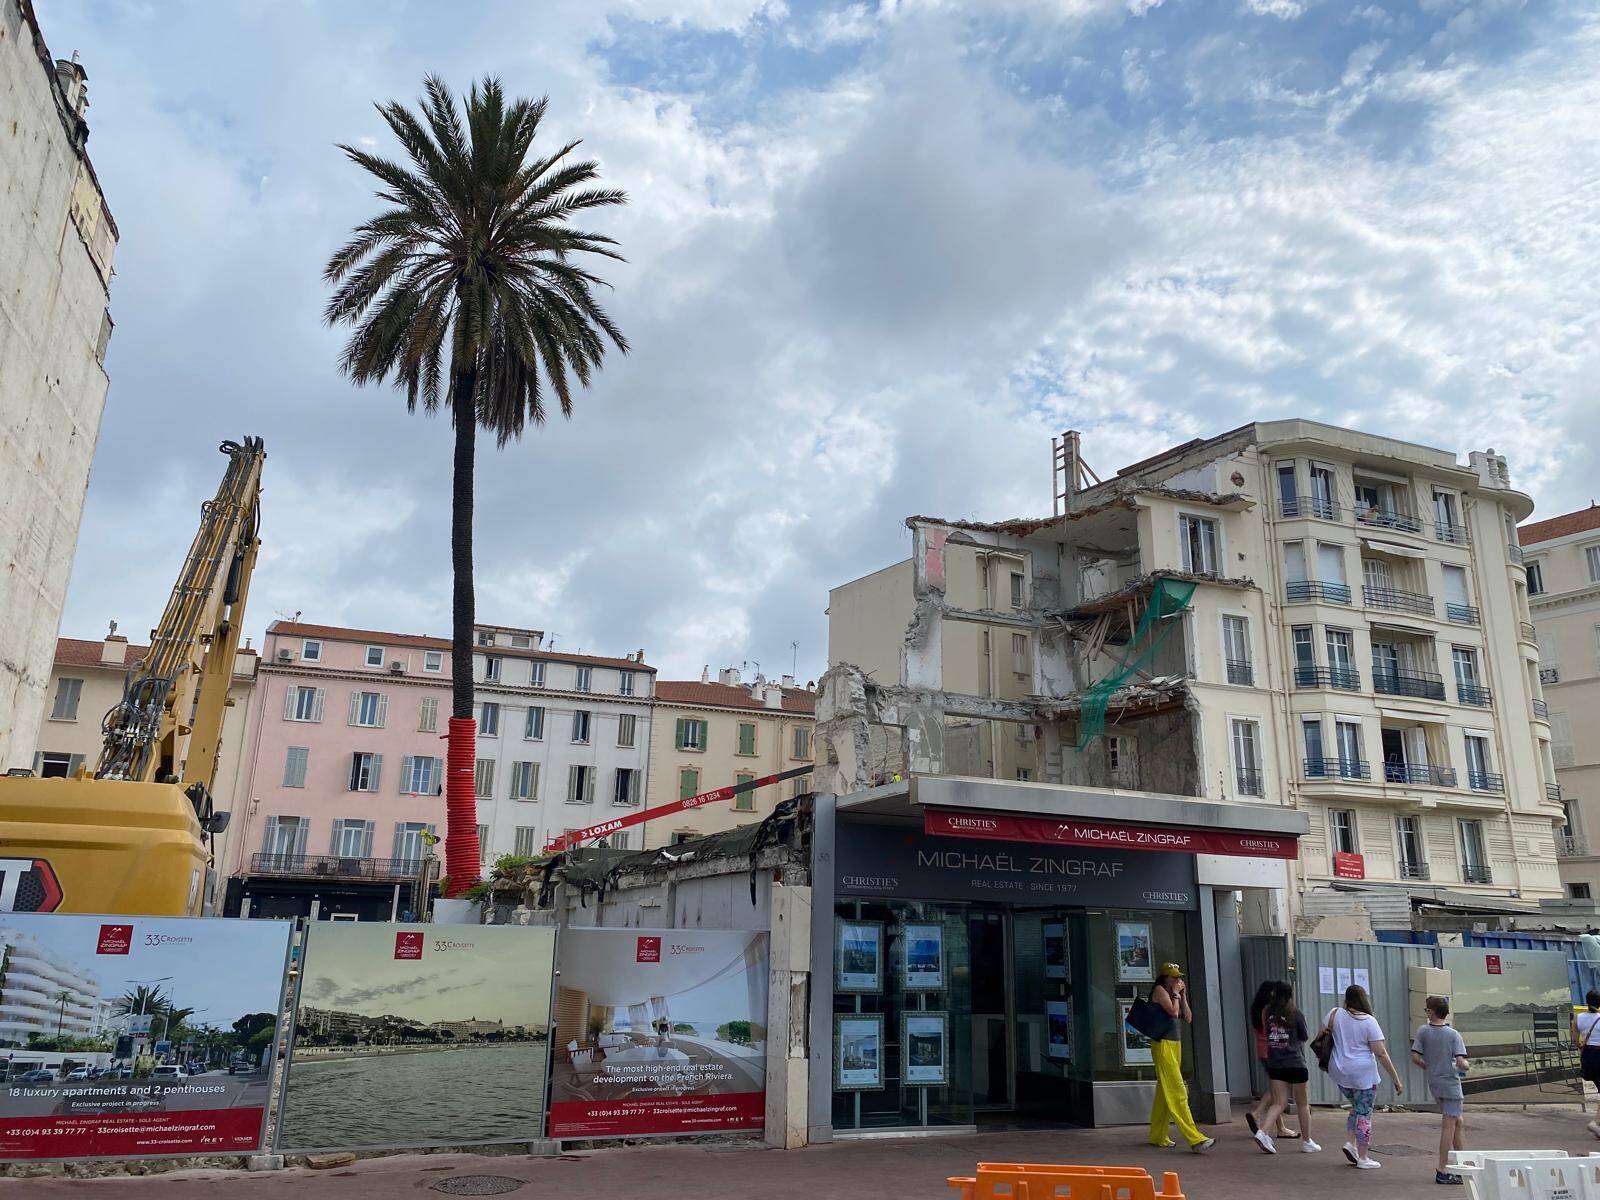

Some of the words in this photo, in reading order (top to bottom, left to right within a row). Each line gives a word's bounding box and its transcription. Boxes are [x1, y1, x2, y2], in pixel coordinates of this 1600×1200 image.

[682, 798, 697, 808] 0826
[698, 796, 706, 804] 16
[706, 791, 721, 800] 1234
[589, 820, 623, 836] LOXAM
[948, 817, 997, 828] CHRISTIE'S
[1074, 828, 1135, 842] MICHAËL
[1136, 832, 1191, 845] ZINGRAF
[1240, 839, 1280, 849] CHRISTIE'S
[917, 850, 1022, 872] MICHAËL
[1029, 857, 1123, 878] ZINGRAF
[842, 875, 899, 887] CHRISTIE'S
[971, 880, 991, 888] REAL
[994, 880, 1023, 890] ESTATE
[1030, 882, 1054, 892] SINCE
[1057, 884, 1077, 893] 1977
[1142, 891, 1189, 902] CHRISTIE'S
[606, 1065, 621, 1073] The
[623, 1065, 643, 1073] most
[645, 1064, 681, 1074] high-end
[683, 1063, 698, 1071] real
[700, 1063, 723, 1071] estate
[593, 1075, 647, 1084] development
[676, 1073, 703, 1081] French
[9, 1088, 20, 1097] 18
[23, 1087, 59, 1098] luxury
[62, 1086, 127, 1097] apartments
[130, 1086, 151, 1095] and
[154, 1085, 161, 1094] 2
[163, 1084, 226, 1096] penthouses
[97, 1123, 216, 1134] 33croisette@michaelzingraf.com
